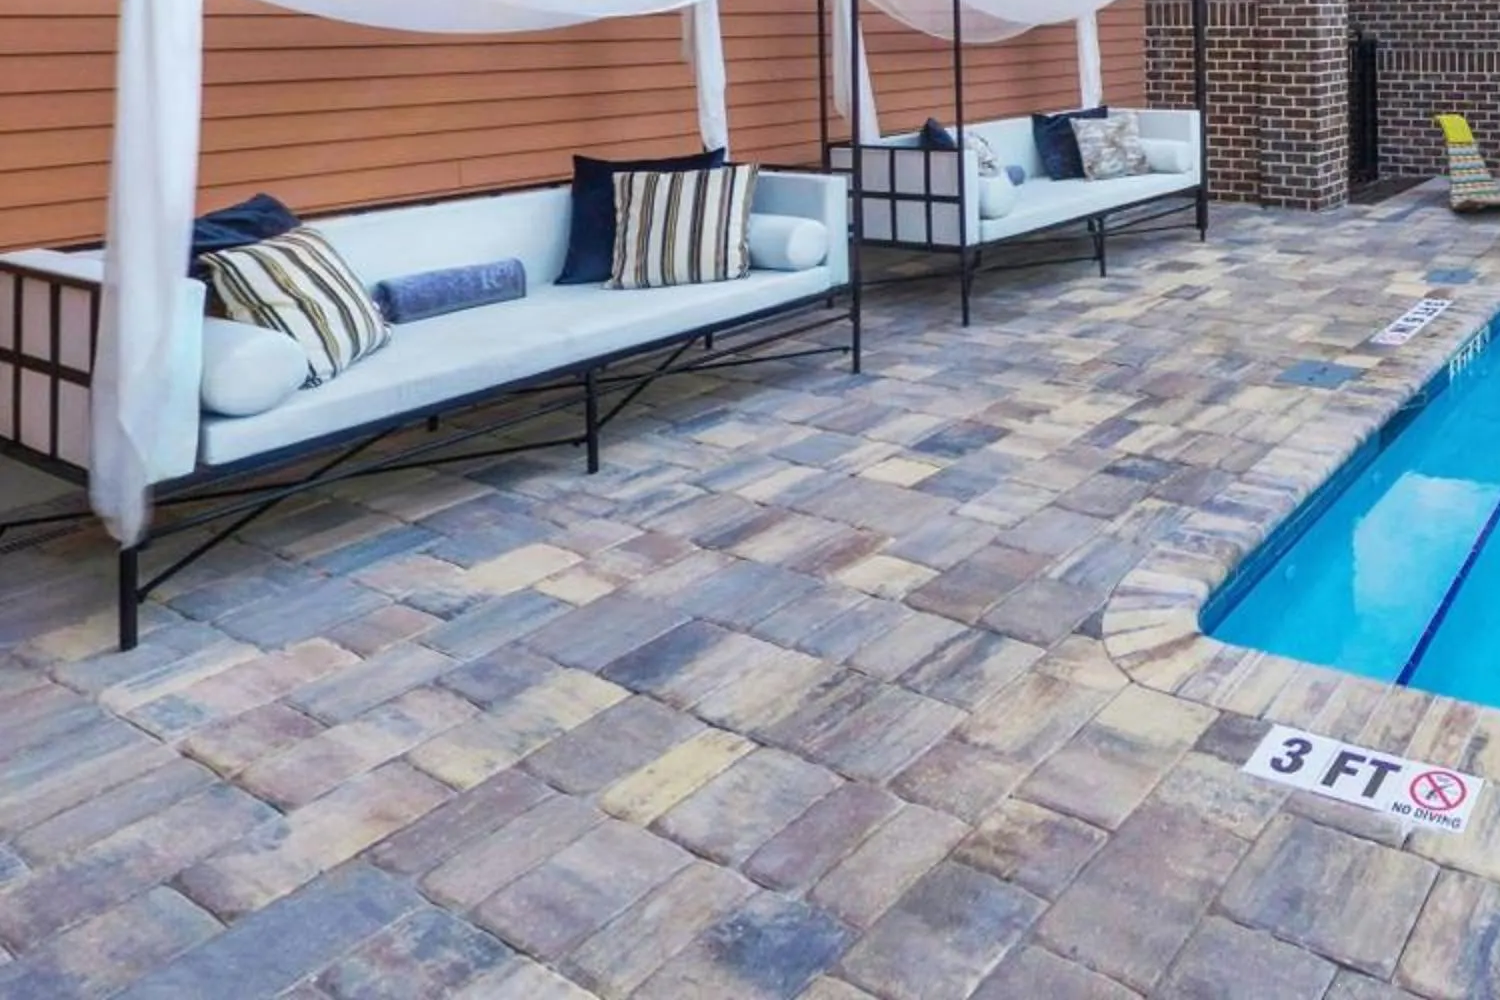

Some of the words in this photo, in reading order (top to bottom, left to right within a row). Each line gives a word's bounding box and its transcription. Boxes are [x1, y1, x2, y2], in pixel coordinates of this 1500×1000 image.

[1269, 737, 1314, 775] 3
[1320, 749, 1403, 800] FT
[1391, 801, 1412, 815] NO
[1413, 807, 1463, 829] DIVING
